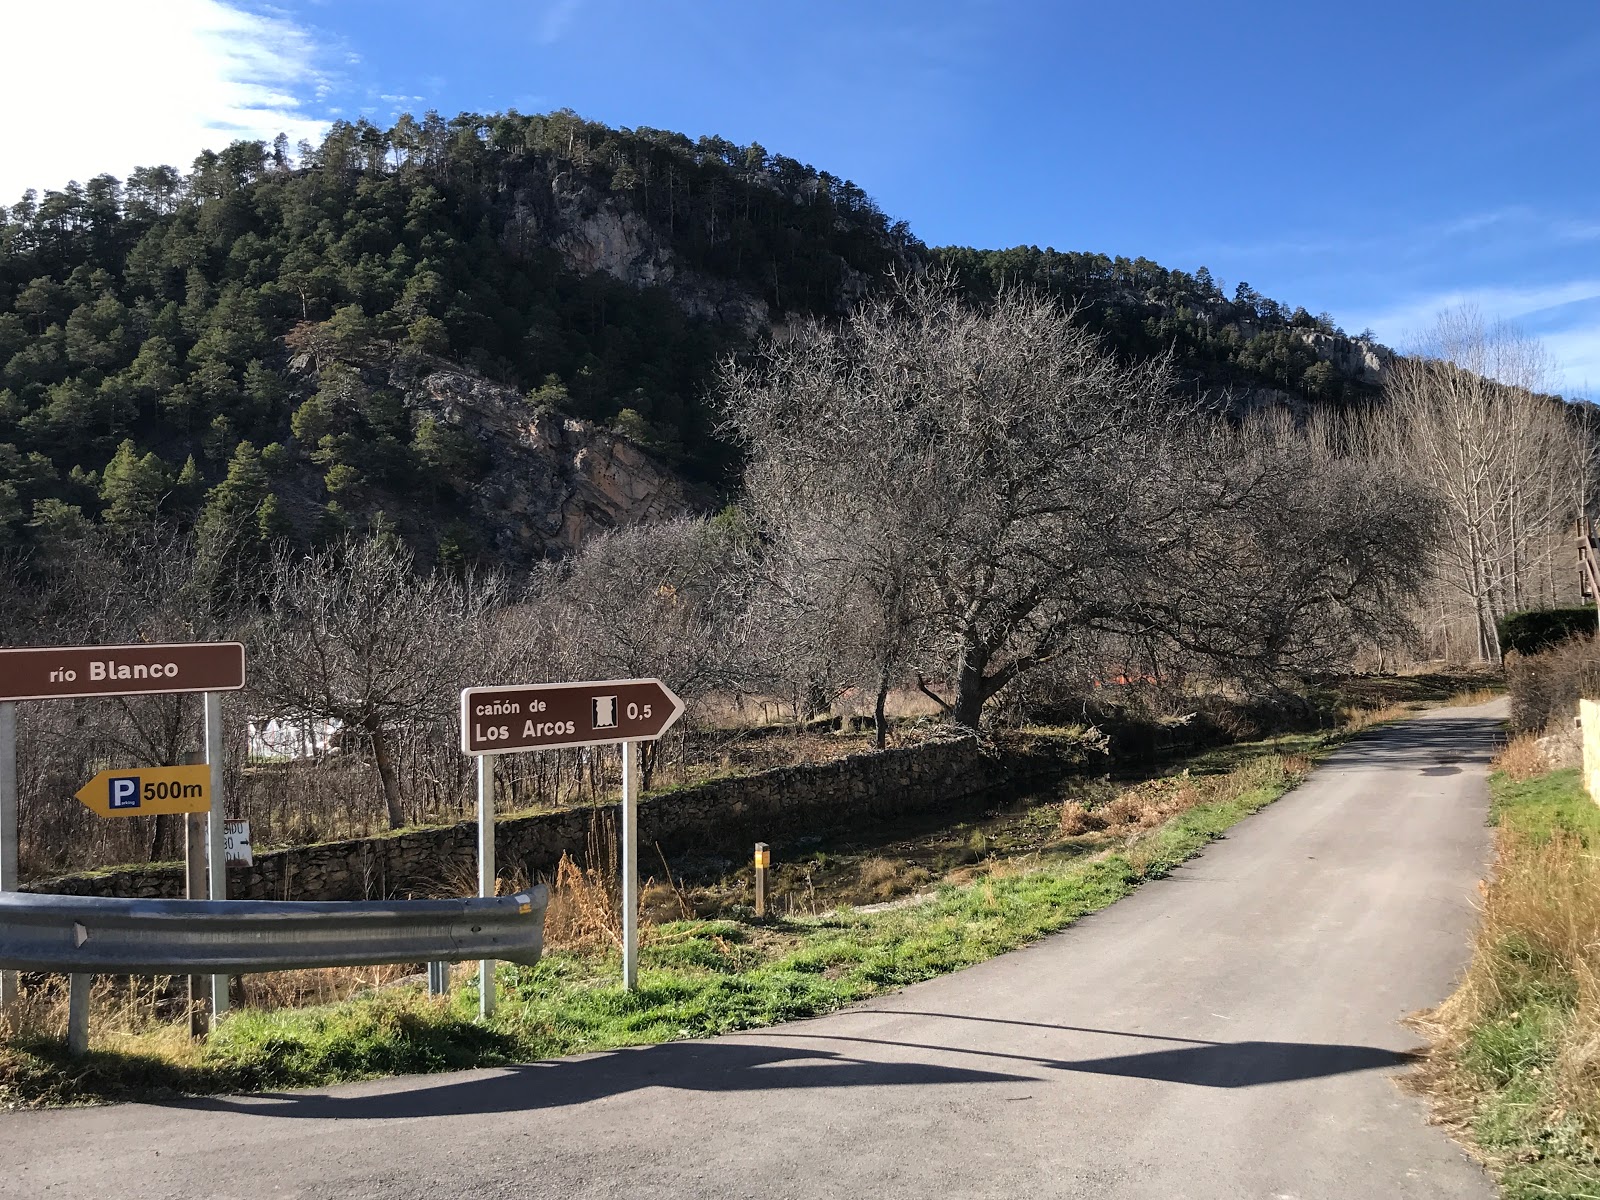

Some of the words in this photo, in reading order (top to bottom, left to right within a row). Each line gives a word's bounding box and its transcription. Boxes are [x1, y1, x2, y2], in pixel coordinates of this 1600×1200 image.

[50, 667, 77, 682] río
[90, 661, 178, 680] Blanco
[476, 700, 520, 716] cañón
[530, 700, 546, 712] de
[627, 703, 651, 720] 0,5
[476, 724, 509, 741] Los
[523, 720, 575, 738] Arcos
[144, 781, 202, 800] 500m
